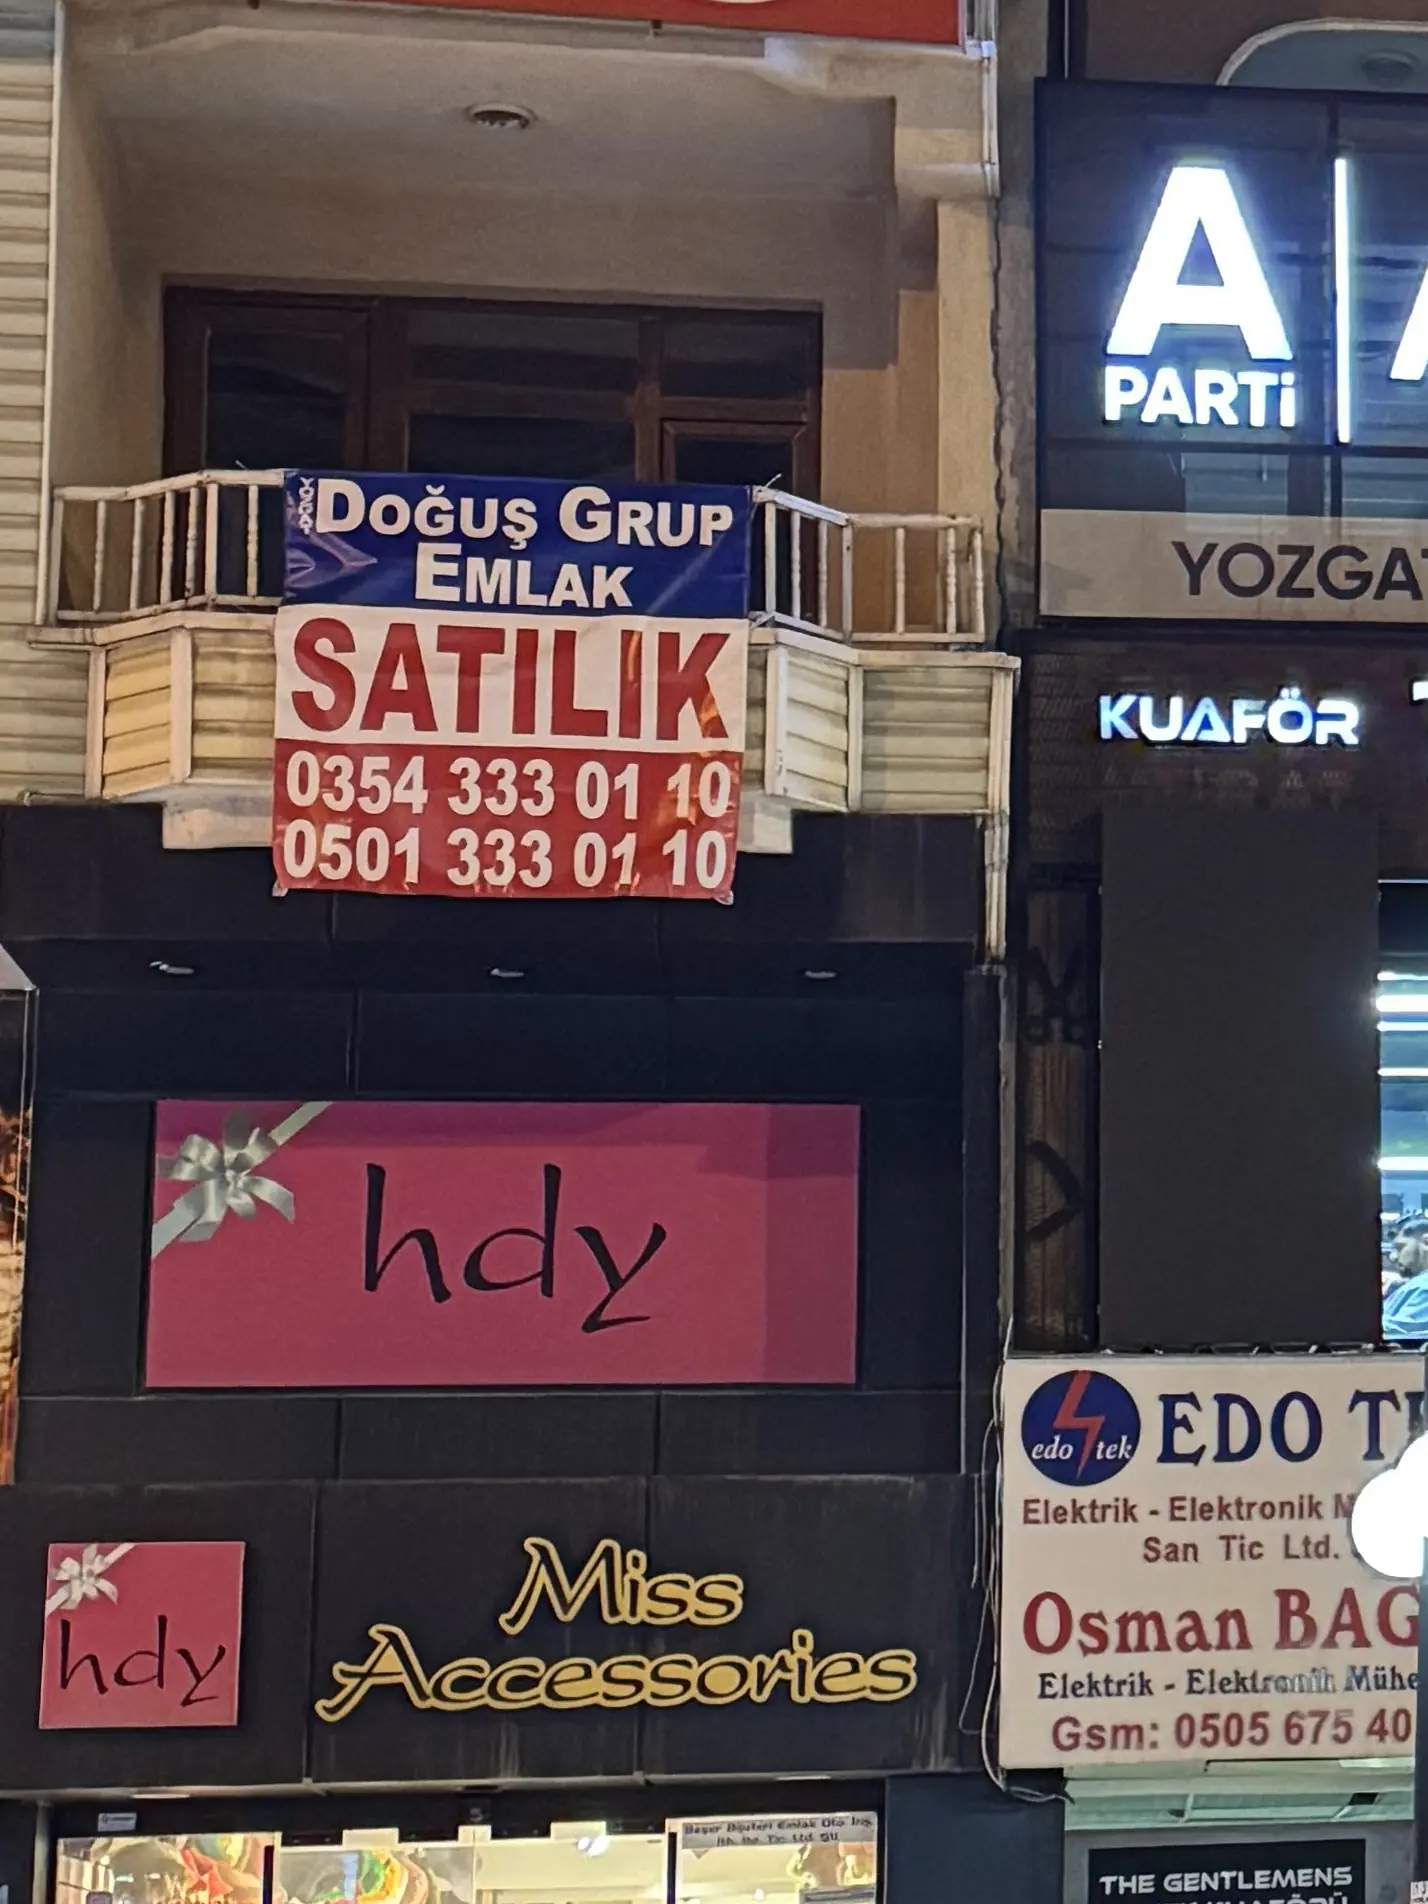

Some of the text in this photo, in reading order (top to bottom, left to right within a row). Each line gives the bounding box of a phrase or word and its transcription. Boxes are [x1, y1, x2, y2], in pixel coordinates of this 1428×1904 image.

[1104, 163, 1295, 362] A
[291, 617, 730, 741] SATILIK
[1100, 686, 1360, 745] KUAFÖR
[286, 750, 732, 820] 0354 333 01 10
[282, 819, 728, 889] 0501 333 01 10
[364, 1162, 667, 1333] hdy
[1031, 1438, 1134, 1461] edo tek
[1156, 1390, 1323, 1467] EDO
[1023, 1495, 1139, 1525] Elektrik
[1168, 1493, 1323, 1523] Elektronik
[1143, 1533, 1340, 1564] San Tic Ltd.
[499, 1537, 744, 1636] Miss
[59, 1612, 227, 1706] hdy
[1023, 1591, 1253, 1657] Osman
[315, 1625, 918, 1723] Accessories
[1038, 1671, 1154, 1700] Elektrik
[1052, 1715, 1160, 1753] Gsm:
[1175, 1711, 1270, 1748] 0505
[1284, 1708, 1353, 1746] 675
[1368, 1707, 1412, 1744] 40
[1099, 1866, 1353, 1896] THE GENTLEMENS
